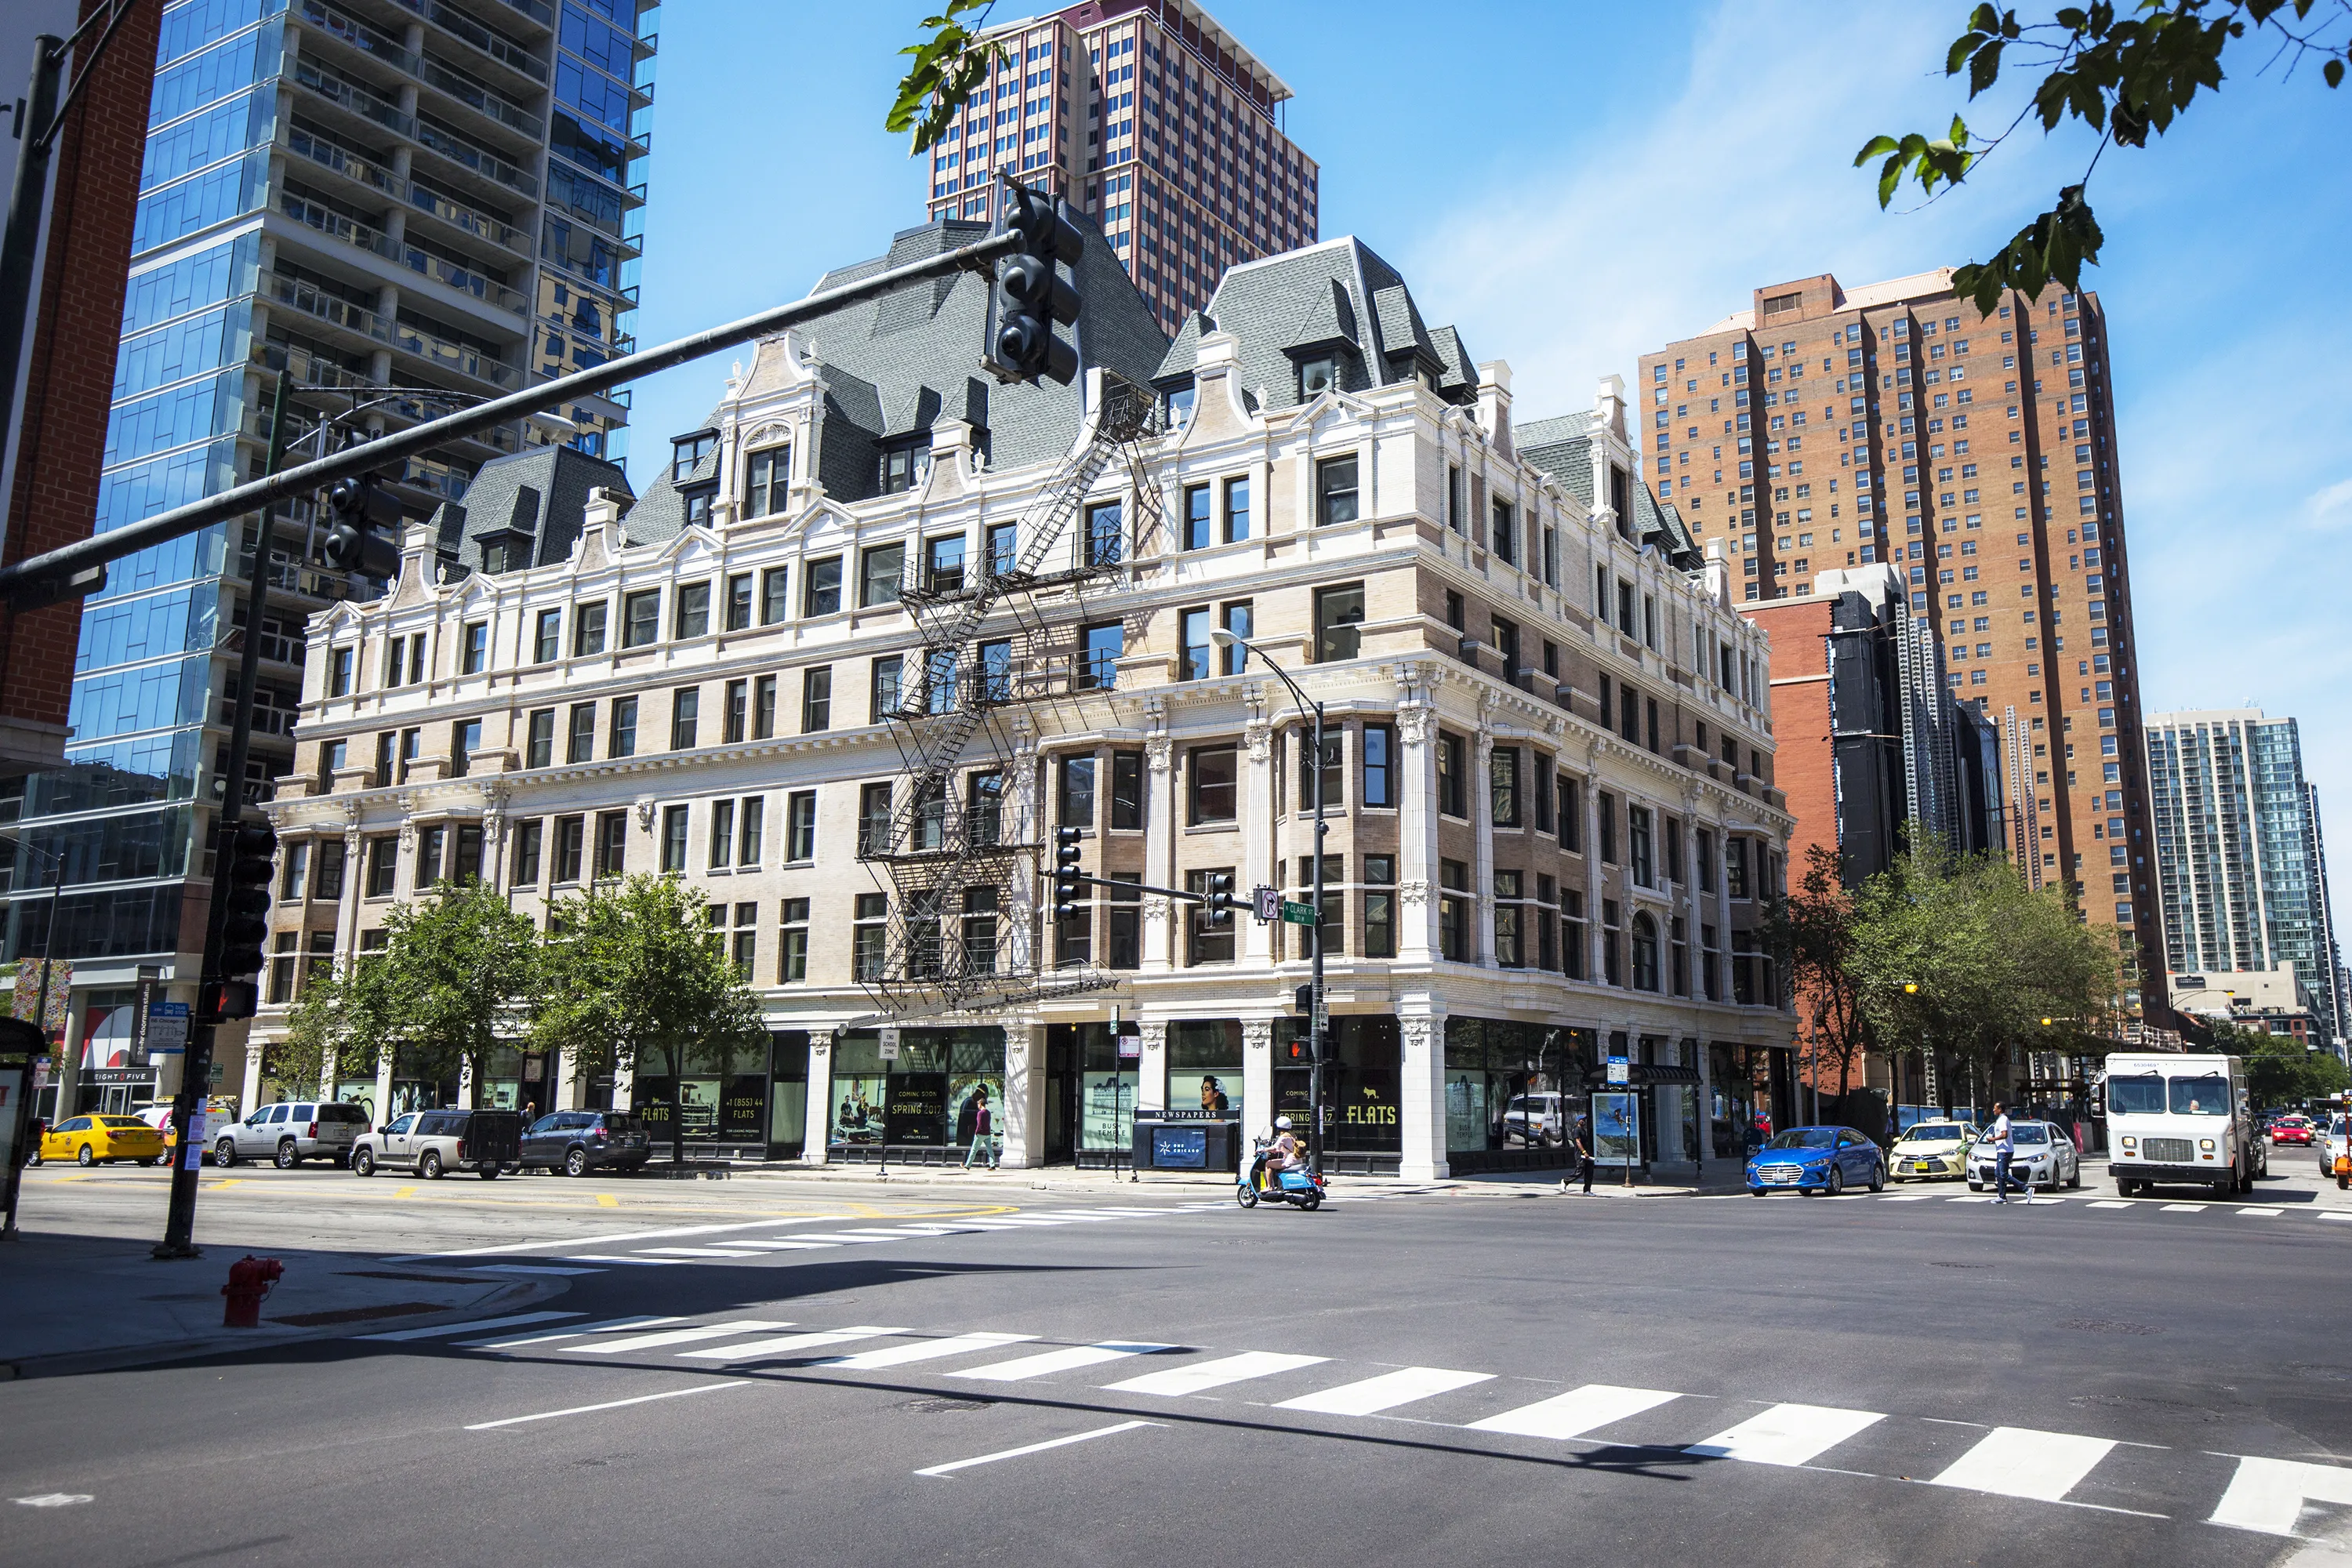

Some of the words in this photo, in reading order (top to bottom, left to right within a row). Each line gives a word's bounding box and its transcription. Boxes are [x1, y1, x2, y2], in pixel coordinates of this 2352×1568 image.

[1290, 905, 1308, 916] CLARK
[140, 1005, 148, 1036] doorman
[734, 1098, 753, 1107] (855)
[641, 1108, 670, 1121] FLATS
[733, 1110, 754, 1119] FLATS
[892, 1105, 921, 1114] SPRING
[924, 1105, 942, 1114] 2017
[1346, 1105, 1396, 1125] FLATS
